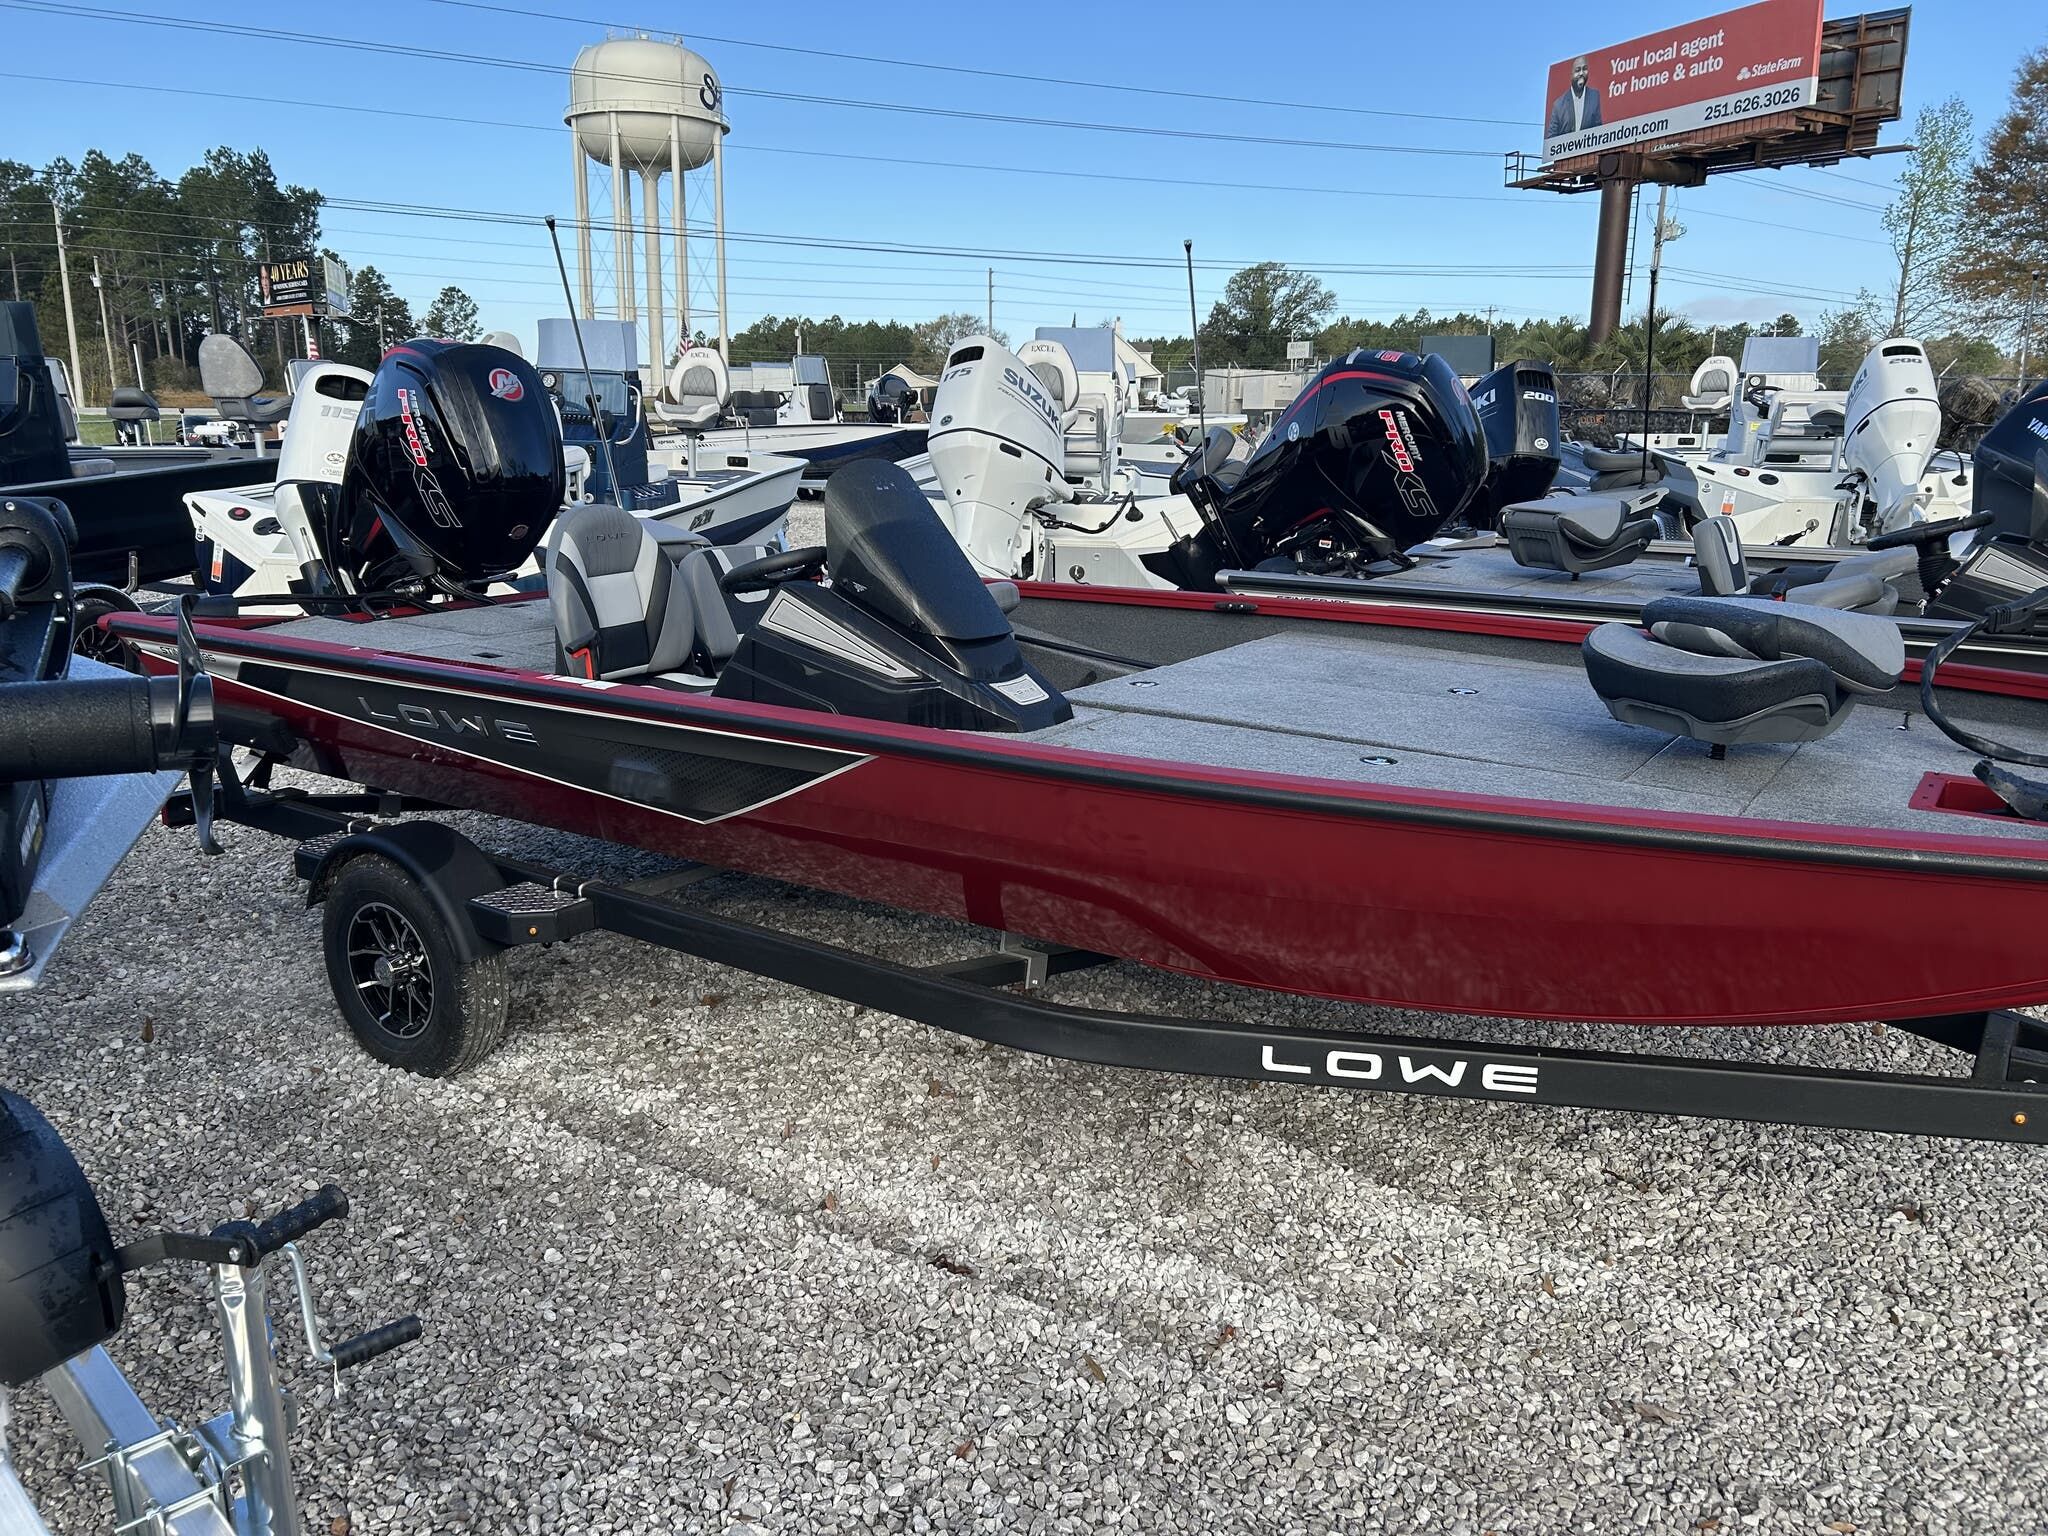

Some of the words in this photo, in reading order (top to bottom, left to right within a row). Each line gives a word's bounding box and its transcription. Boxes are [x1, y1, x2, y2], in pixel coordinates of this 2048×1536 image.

[1610, 55, 1640, 75] Your
[1642, 41, 1678, 67] local
[1680, 28, 1725, 58] agent
[1608, 80, 1628, 98] for
[1630, 70, 1670, 92] home
[1672, 62, 1686, 81] &
[1689, 55, 1724, 77] auto
[1704, 87, 1801, 120] 251.626.3026
[1549, 118, 1669, 157] savewithrandon.com
[271, 264, 280, 282] 40
[280, 260, 309, 281] YEARS
[1031, 344, 1057, 353] EXCEL
[943, 366, 973, 383] 175
[1523, 390, 1554, 403] 200
[408, 389, 435, 453] MERCURY
[1003, 367, 1062, 435] SUZUKI
[397, 388, 428, 467] PRO
[1378, 410, 1414, 472] PRO
[1396, 411, 1423, 461] MERCURY
[357, 696, 541, 747] LOWE
[1261, 1045, 1539, 1094] LOWE
